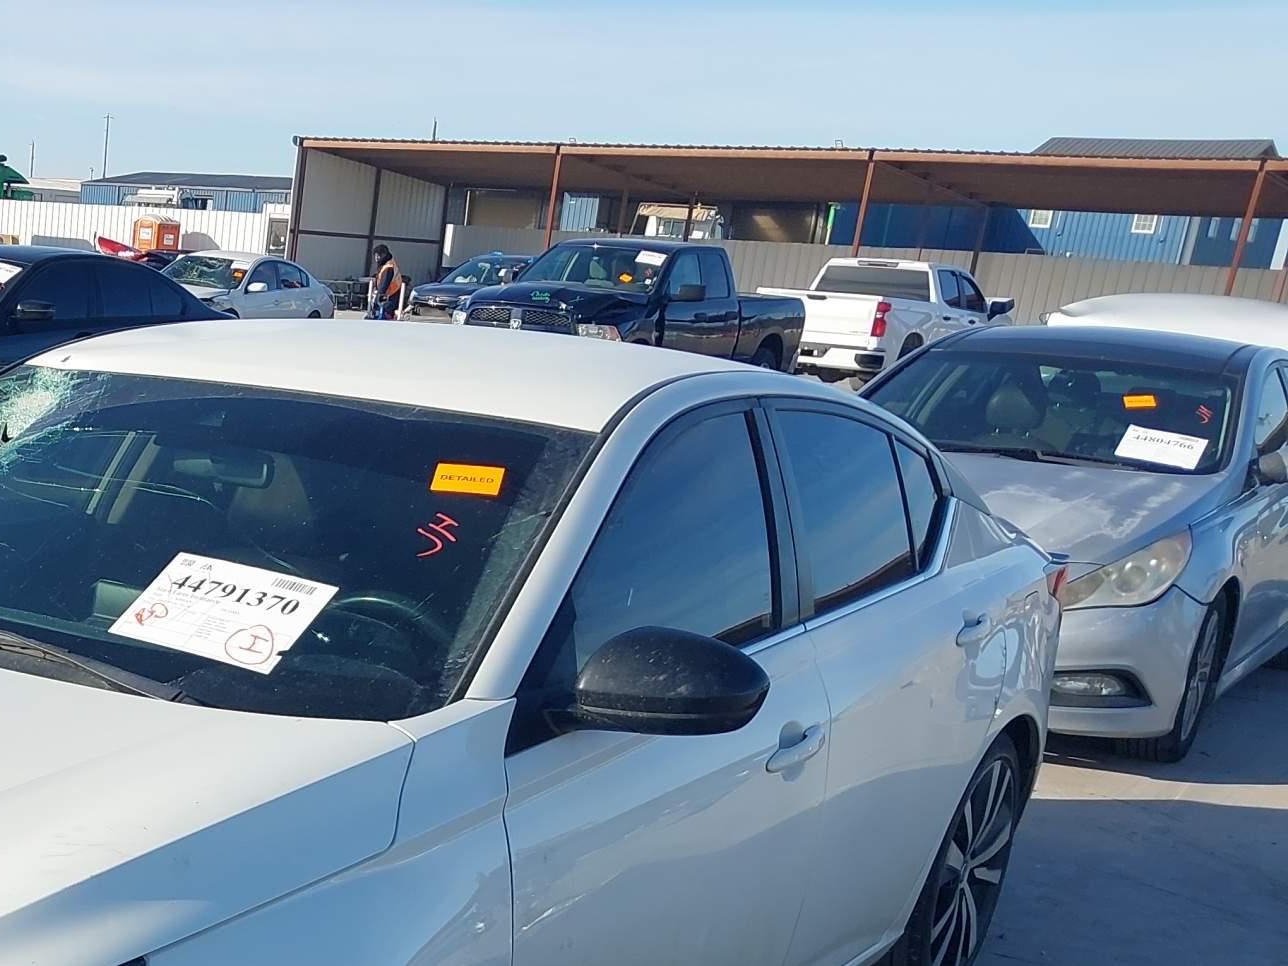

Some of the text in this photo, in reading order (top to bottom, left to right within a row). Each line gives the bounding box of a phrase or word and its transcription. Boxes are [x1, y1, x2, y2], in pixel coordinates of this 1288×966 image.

[1132, 433, 1195, 450] 44804766
[439, 474, 494, 484] DETAILED
[171, 573, 300, 616] 44791370
